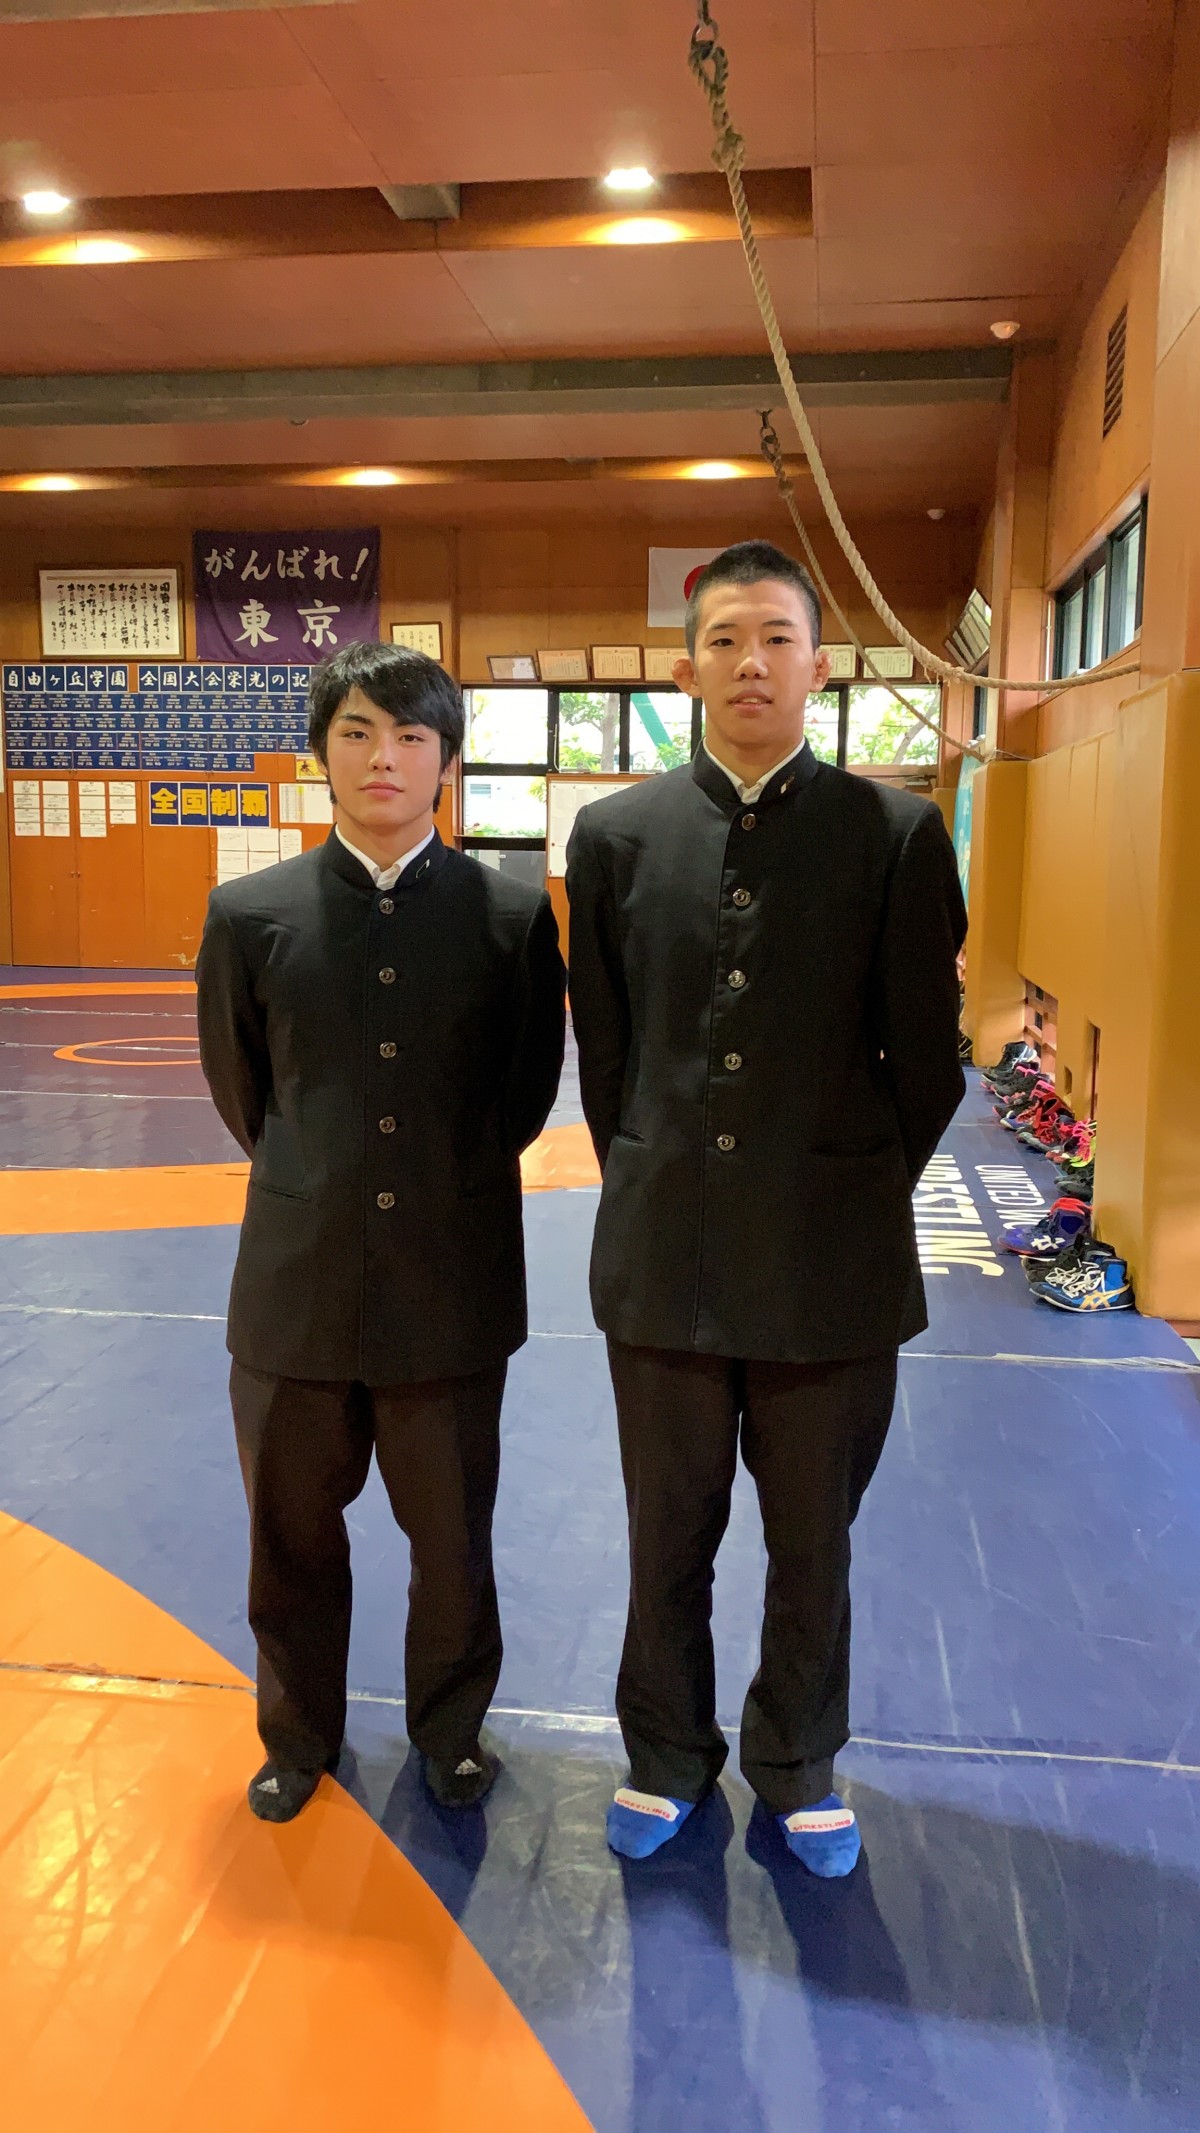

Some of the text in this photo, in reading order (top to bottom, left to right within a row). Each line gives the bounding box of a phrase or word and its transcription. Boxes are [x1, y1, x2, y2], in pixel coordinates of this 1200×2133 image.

[234, 598, 341, 648] 東京
[139, 670, 310, 689] 全国大会栄光の記
[151, 787, 268, 817] 全国制覇
[974, 1164, 1045, 1206] UNITED
